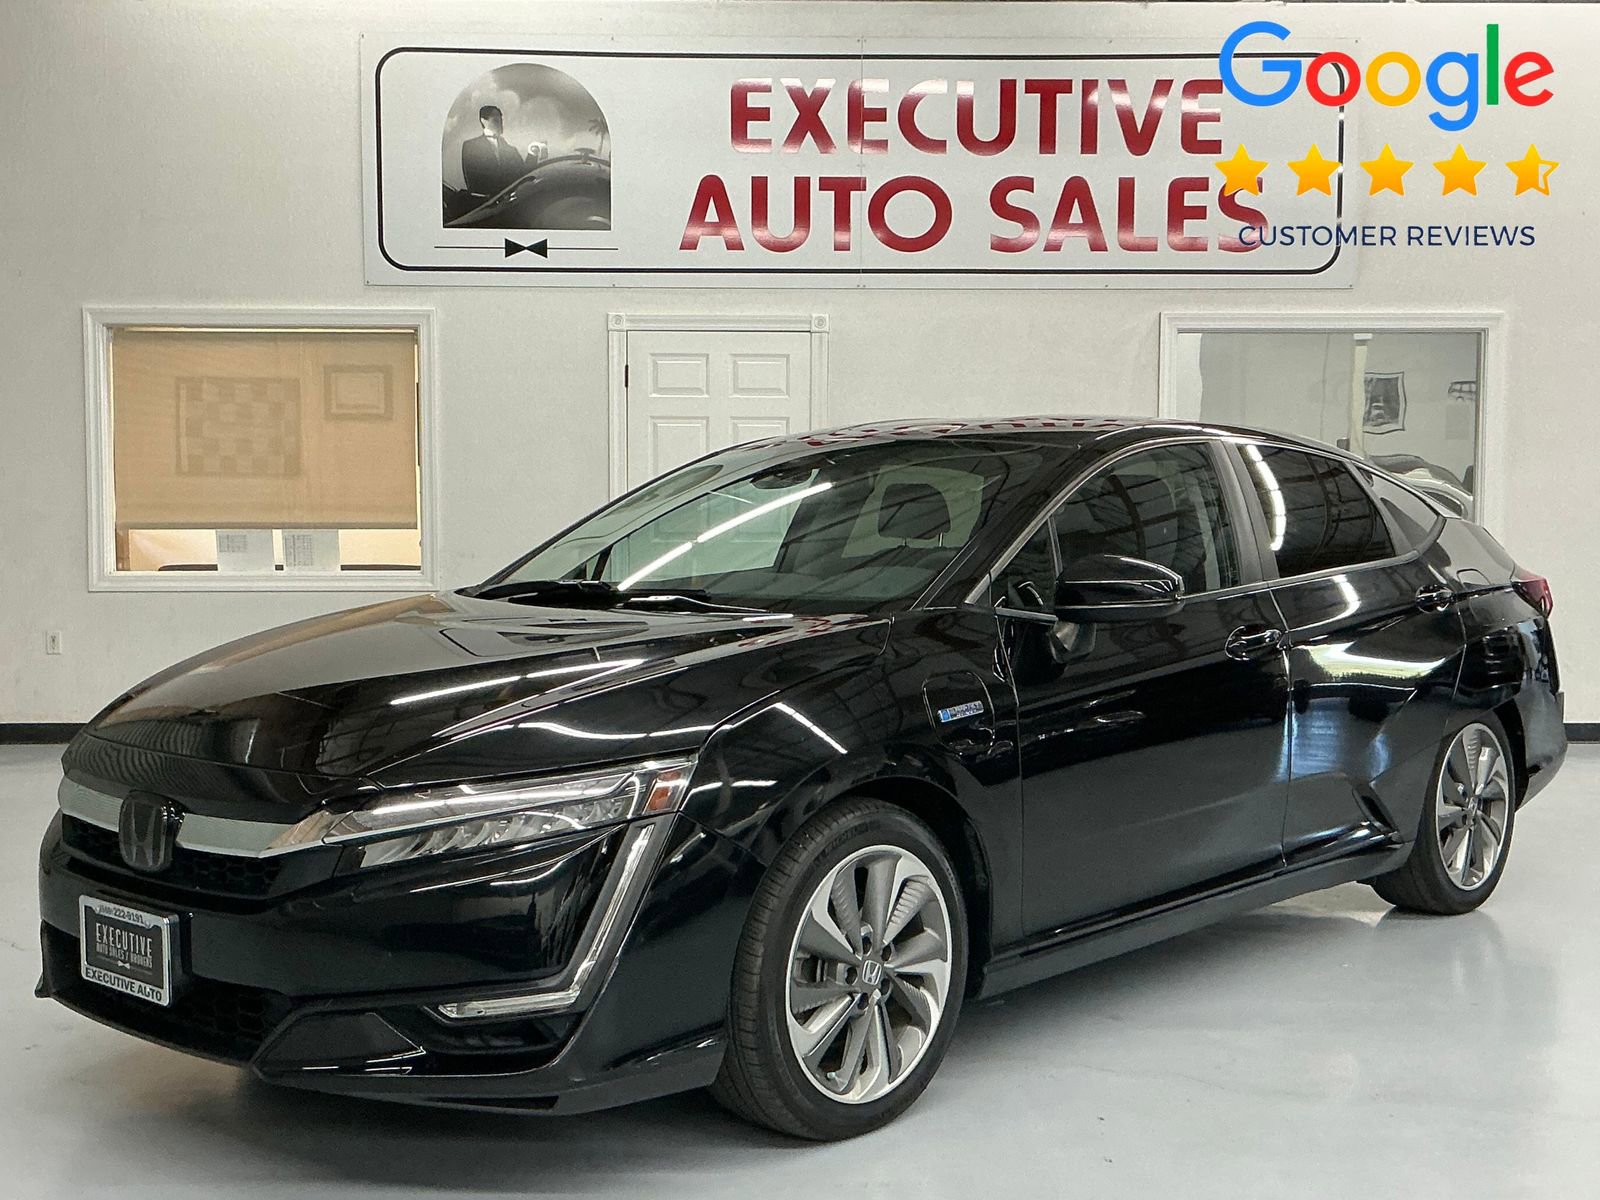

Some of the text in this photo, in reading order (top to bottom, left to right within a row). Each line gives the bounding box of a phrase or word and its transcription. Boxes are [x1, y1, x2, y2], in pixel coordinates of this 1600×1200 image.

[730, 77, 1223, 156] EXECUTIVE
[678, 174, 1269, 253] AUTO SALES
[95, 922, 153, 958] EXECUTIVE
[85, 967, 136, 993] EXECUTIVE
